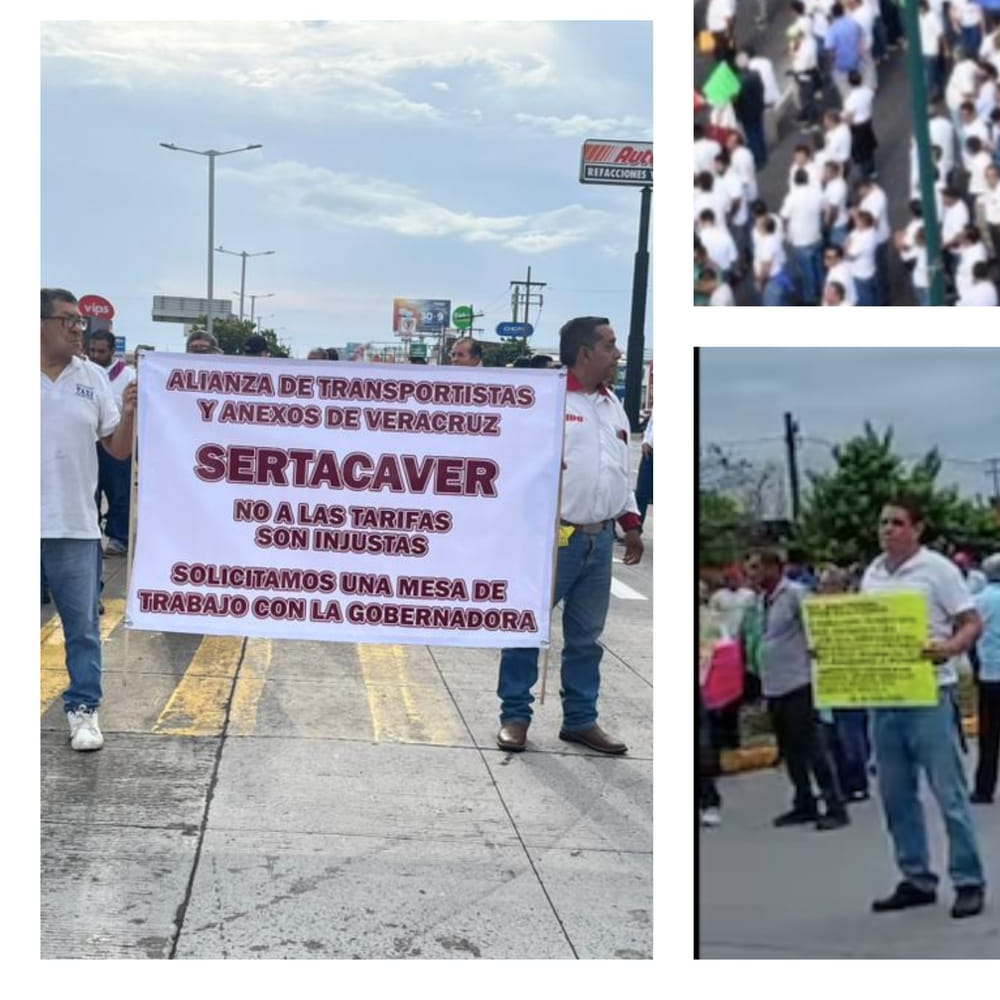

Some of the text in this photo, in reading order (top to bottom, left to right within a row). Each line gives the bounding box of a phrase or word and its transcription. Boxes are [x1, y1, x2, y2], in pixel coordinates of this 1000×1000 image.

[587, 167, 647, 179] REFACCIONES
[84, 303, 110, 316] vips
[166, 369, 535, 409] ALIANZA DE TRANSPORTISTAS
[197, 399, 501, 436] Y ANEXOS DE VERACRUZ
[193, 443, 500, 498] SERTACAVER
[233, 499, 453, 533] NO A LAS TARIFAS
[254, 525, 429, 557] SON INJUSTAS
[171, 561, 508, 603] SOLICITAMOS UNA MESA DE
[138, 589, 538, 633] TRABAJO CON LA GOBERNADORA
